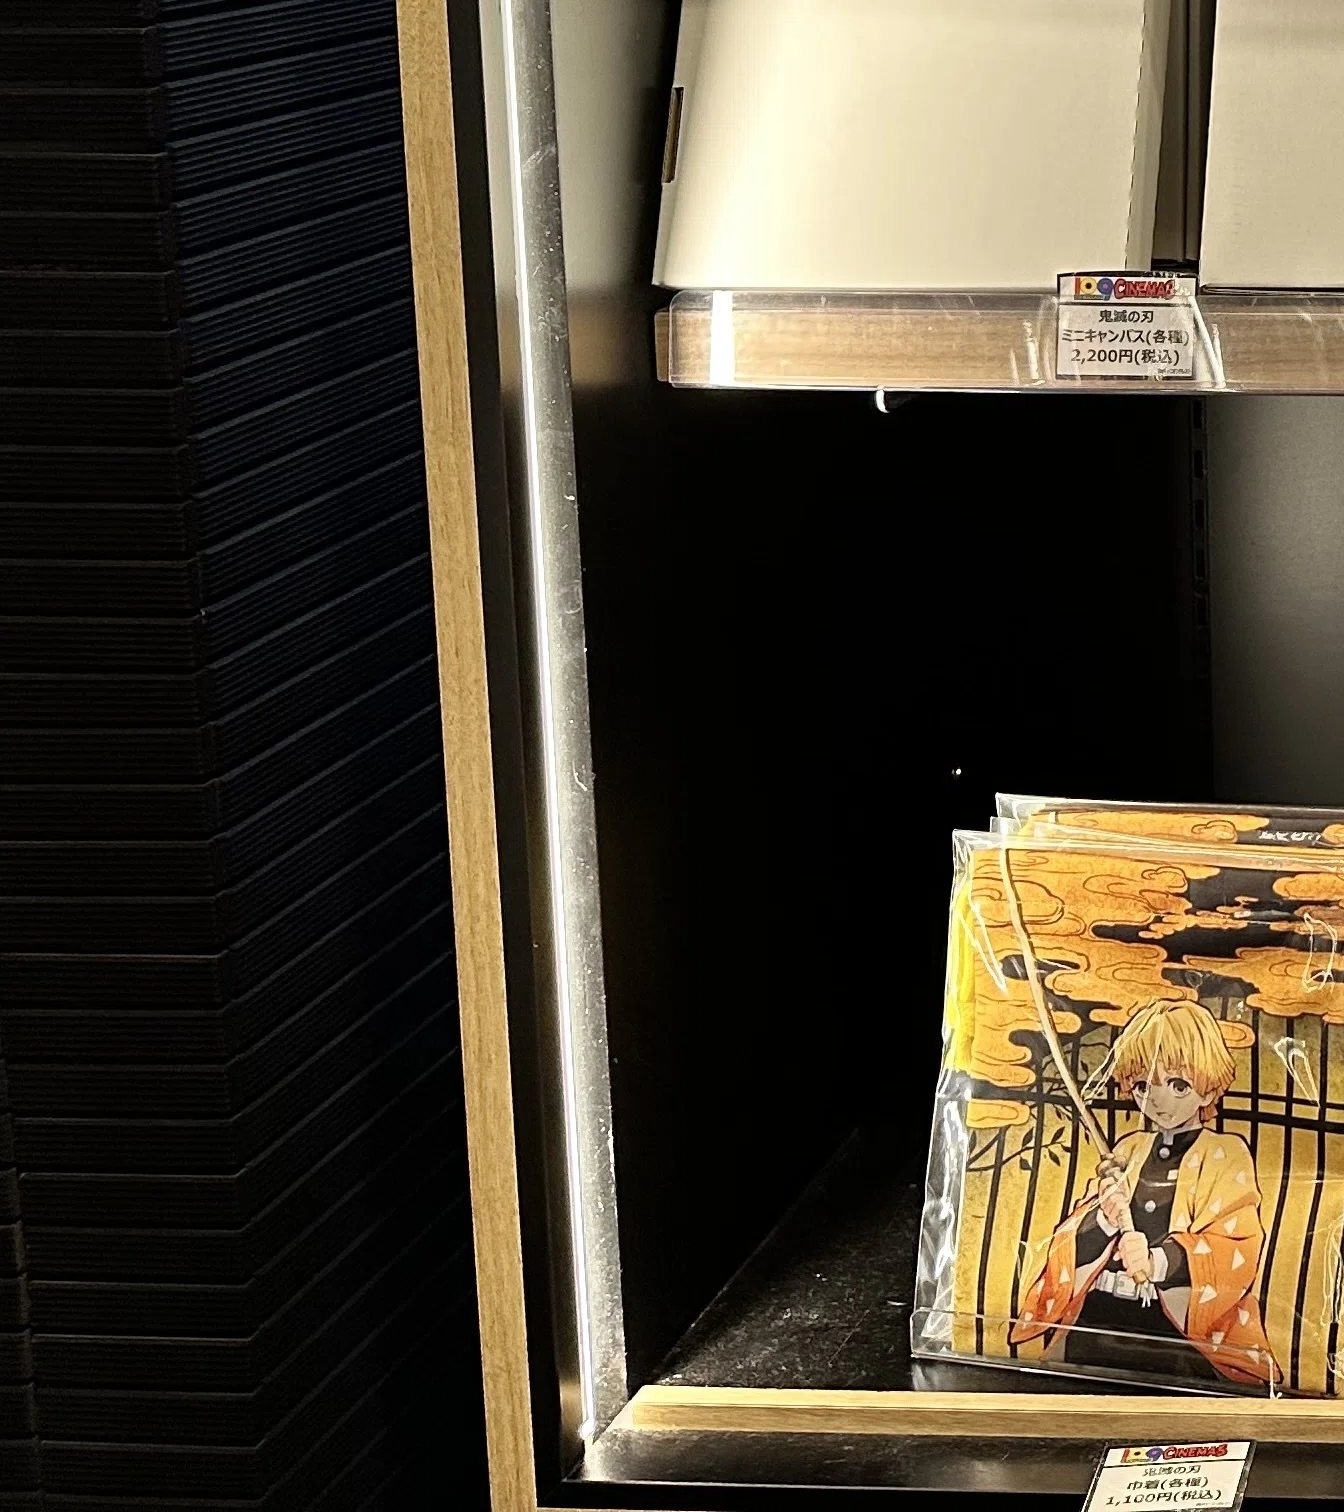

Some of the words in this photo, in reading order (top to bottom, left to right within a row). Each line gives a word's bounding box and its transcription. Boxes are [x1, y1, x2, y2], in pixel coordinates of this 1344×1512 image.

[1099, 310, 1154, 323] 鬼滅の刃
[1071, 349, 1180, 366] 2,200円(税込)
[1162, 1443, 1228, 1461] CINEMAS
[1106, 1490, 1222, 1506] 1,100円(税込)
